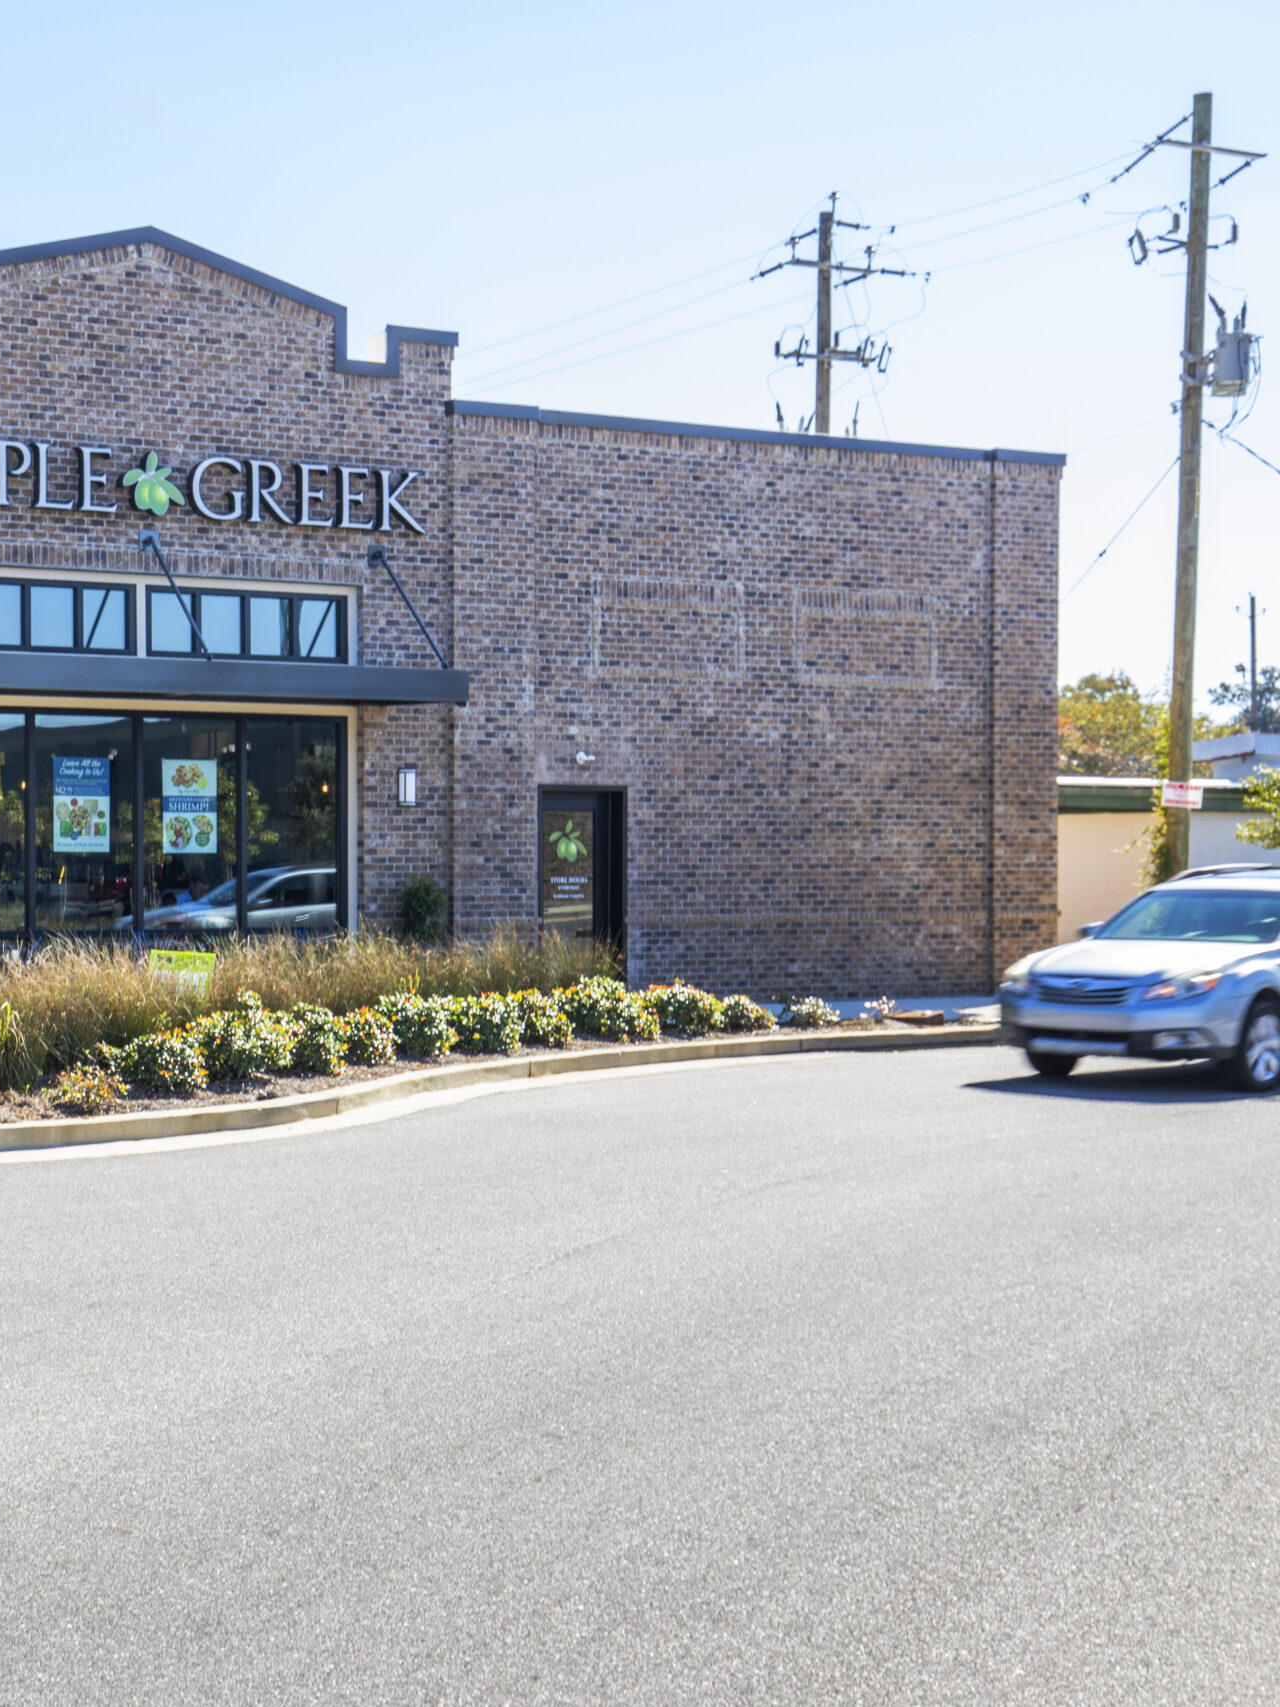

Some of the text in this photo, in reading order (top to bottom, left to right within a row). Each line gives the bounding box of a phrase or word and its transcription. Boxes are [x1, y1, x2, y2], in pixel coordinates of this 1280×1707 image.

[190, 456, 426, 536] GREEK
[60, 766, 84, 779] Cooking
[168, 802, 209, 812] SHRIMP!
